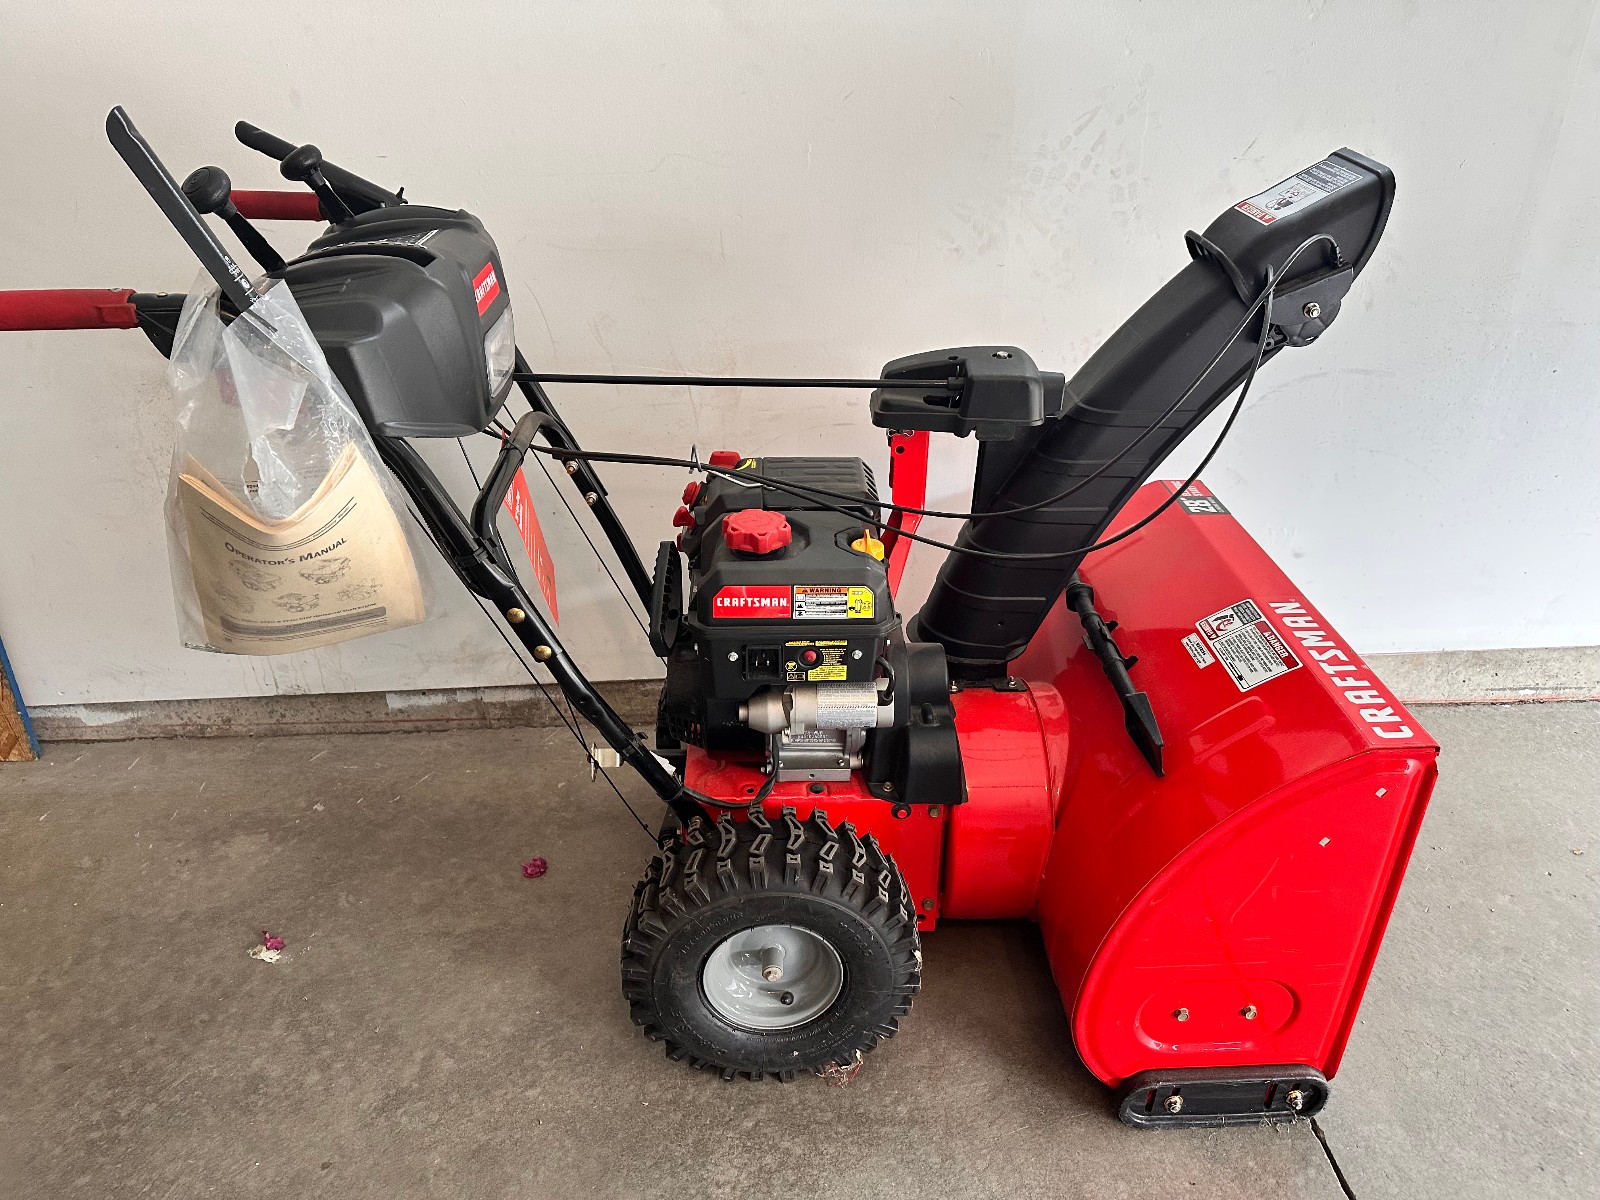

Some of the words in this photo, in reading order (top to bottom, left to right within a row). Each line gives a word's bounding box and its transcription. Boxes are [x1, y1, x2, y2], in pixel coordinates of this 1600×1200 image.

[224, 542, 296, 566] OPERATOR'S
[299, 538, 347, 562] MANUAL
[716, 597, 787, 607] CRAFTSMAN
[1266, 634, 1289, 659] DANGER
[1268, 601, 1414, 739] CRAFTSMAN
